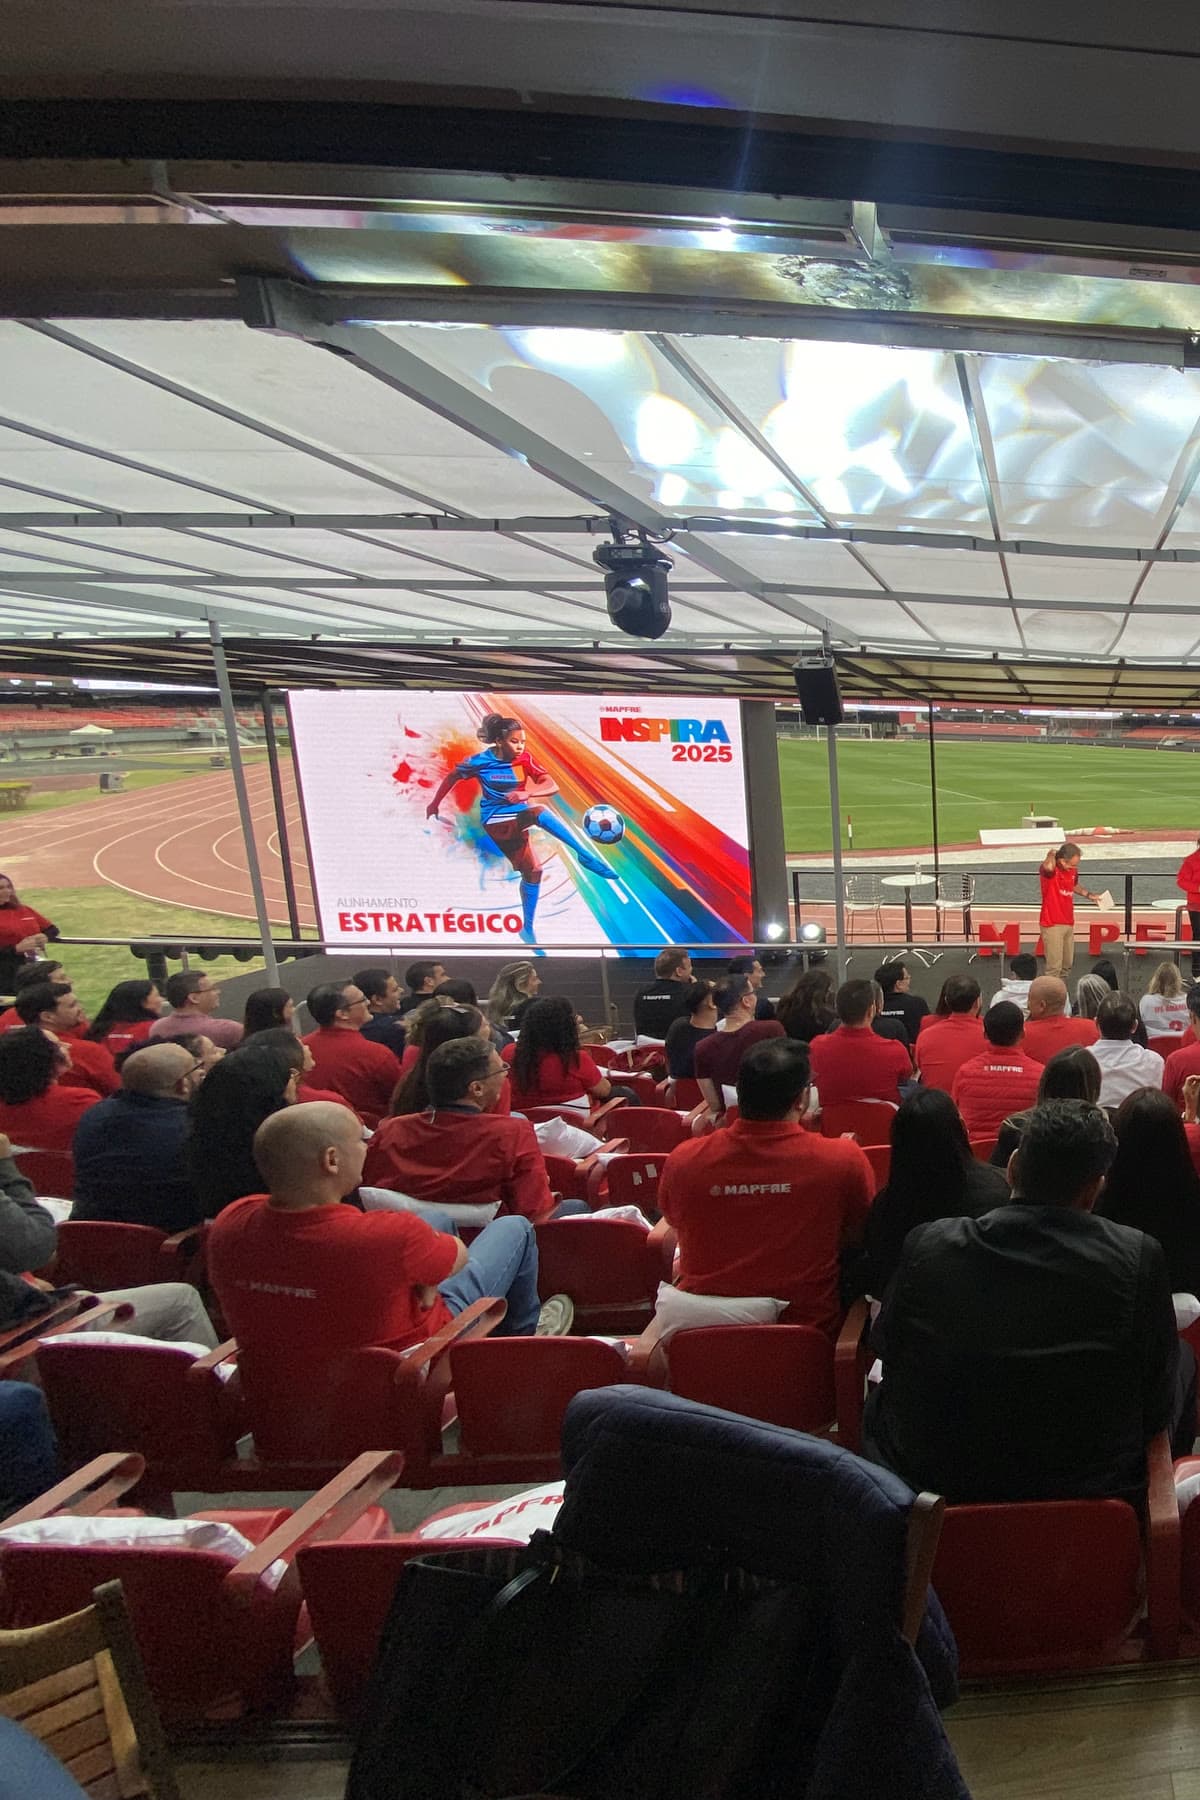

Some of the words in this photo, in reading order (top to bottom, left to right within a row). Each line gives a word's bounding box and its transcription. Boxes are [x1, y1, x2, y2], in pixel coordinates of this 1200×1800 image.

[600, 717, 731, 744] INSPIRA
[671, 744, 733, 763] 2025
[336, 897, 418, 909] ALINHAMENTO
[338, 907, 523, 934] ESTRATÉGICO
[724, 1183, 792, 1195] MAPFRE
